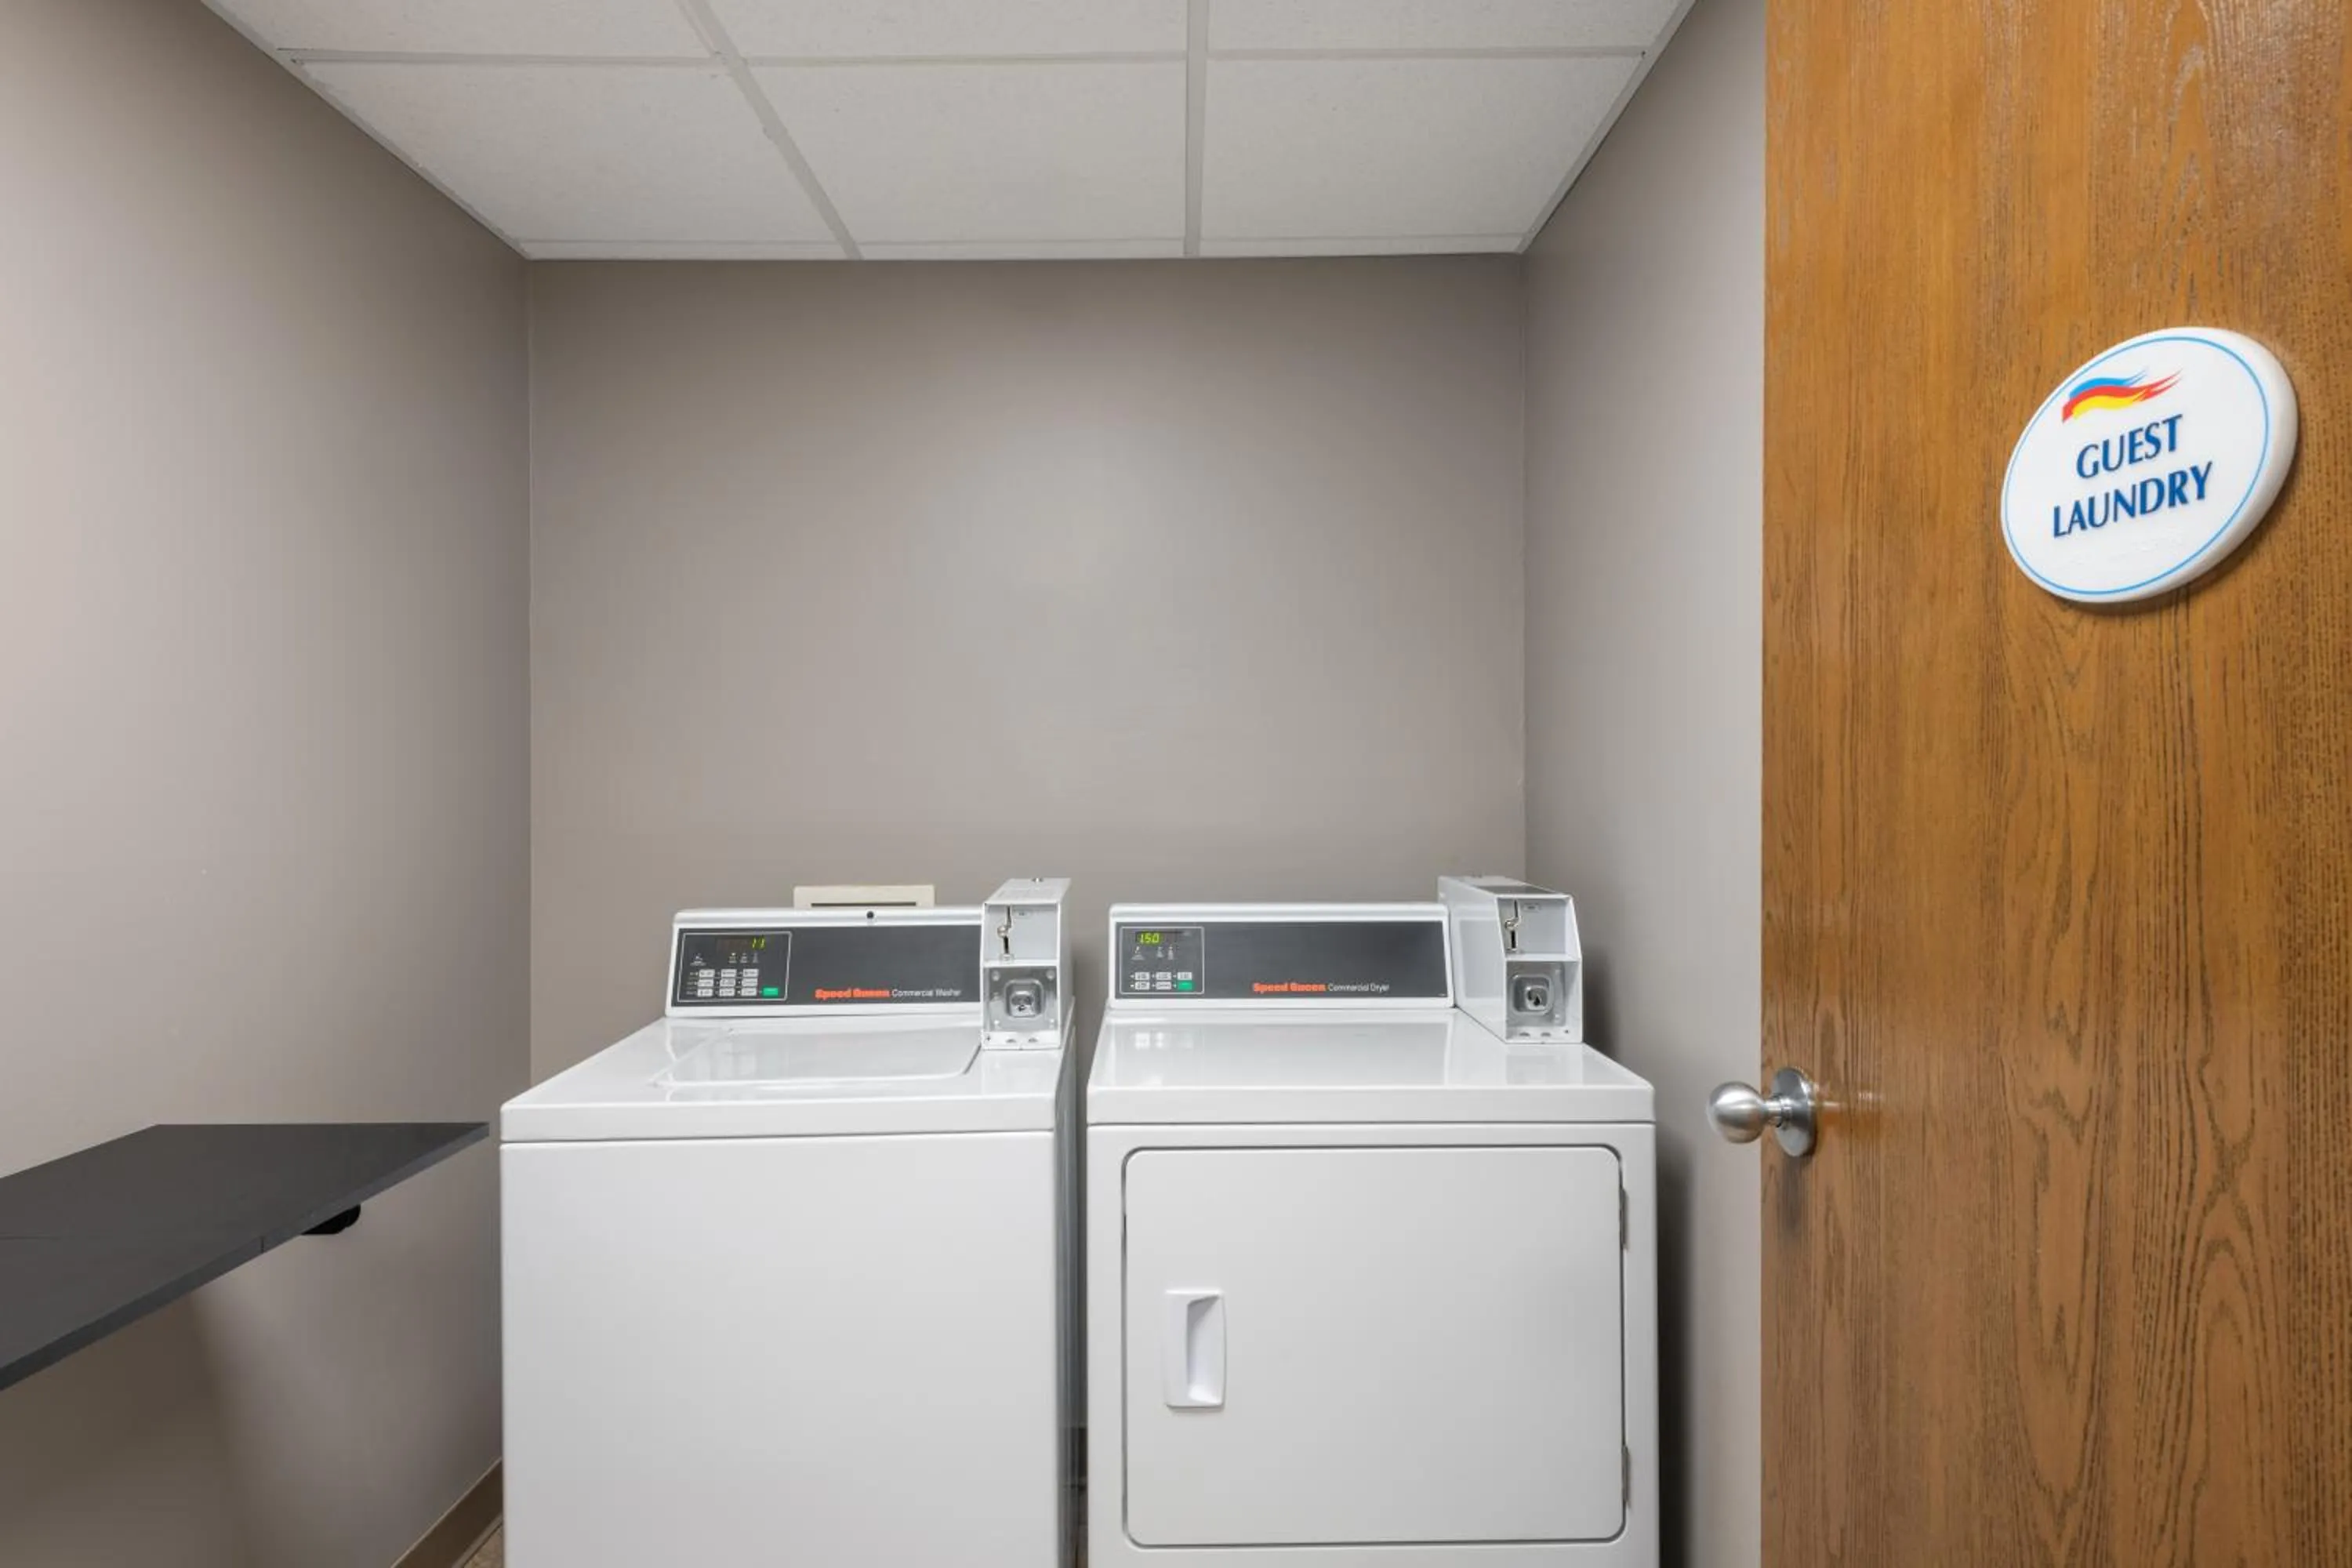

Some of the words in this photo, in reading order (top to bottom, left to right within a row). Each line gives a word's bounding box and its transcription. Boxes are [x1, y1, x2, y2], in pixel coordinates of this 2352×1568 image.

[2076, 413, 2183, 479] GUEST
[2053, 460, 2213, 539] LAUNDRY
[815, 989, 852, 1000] Speed
[891, 989, 933, 997] Commercial
[1253, 982, 1288, 993] Speed
[1290, 983, 1326, 992] Queen
[1328, 982, 1370, 992] Commercial
[1370, 982, 1389, 993] Dryer
